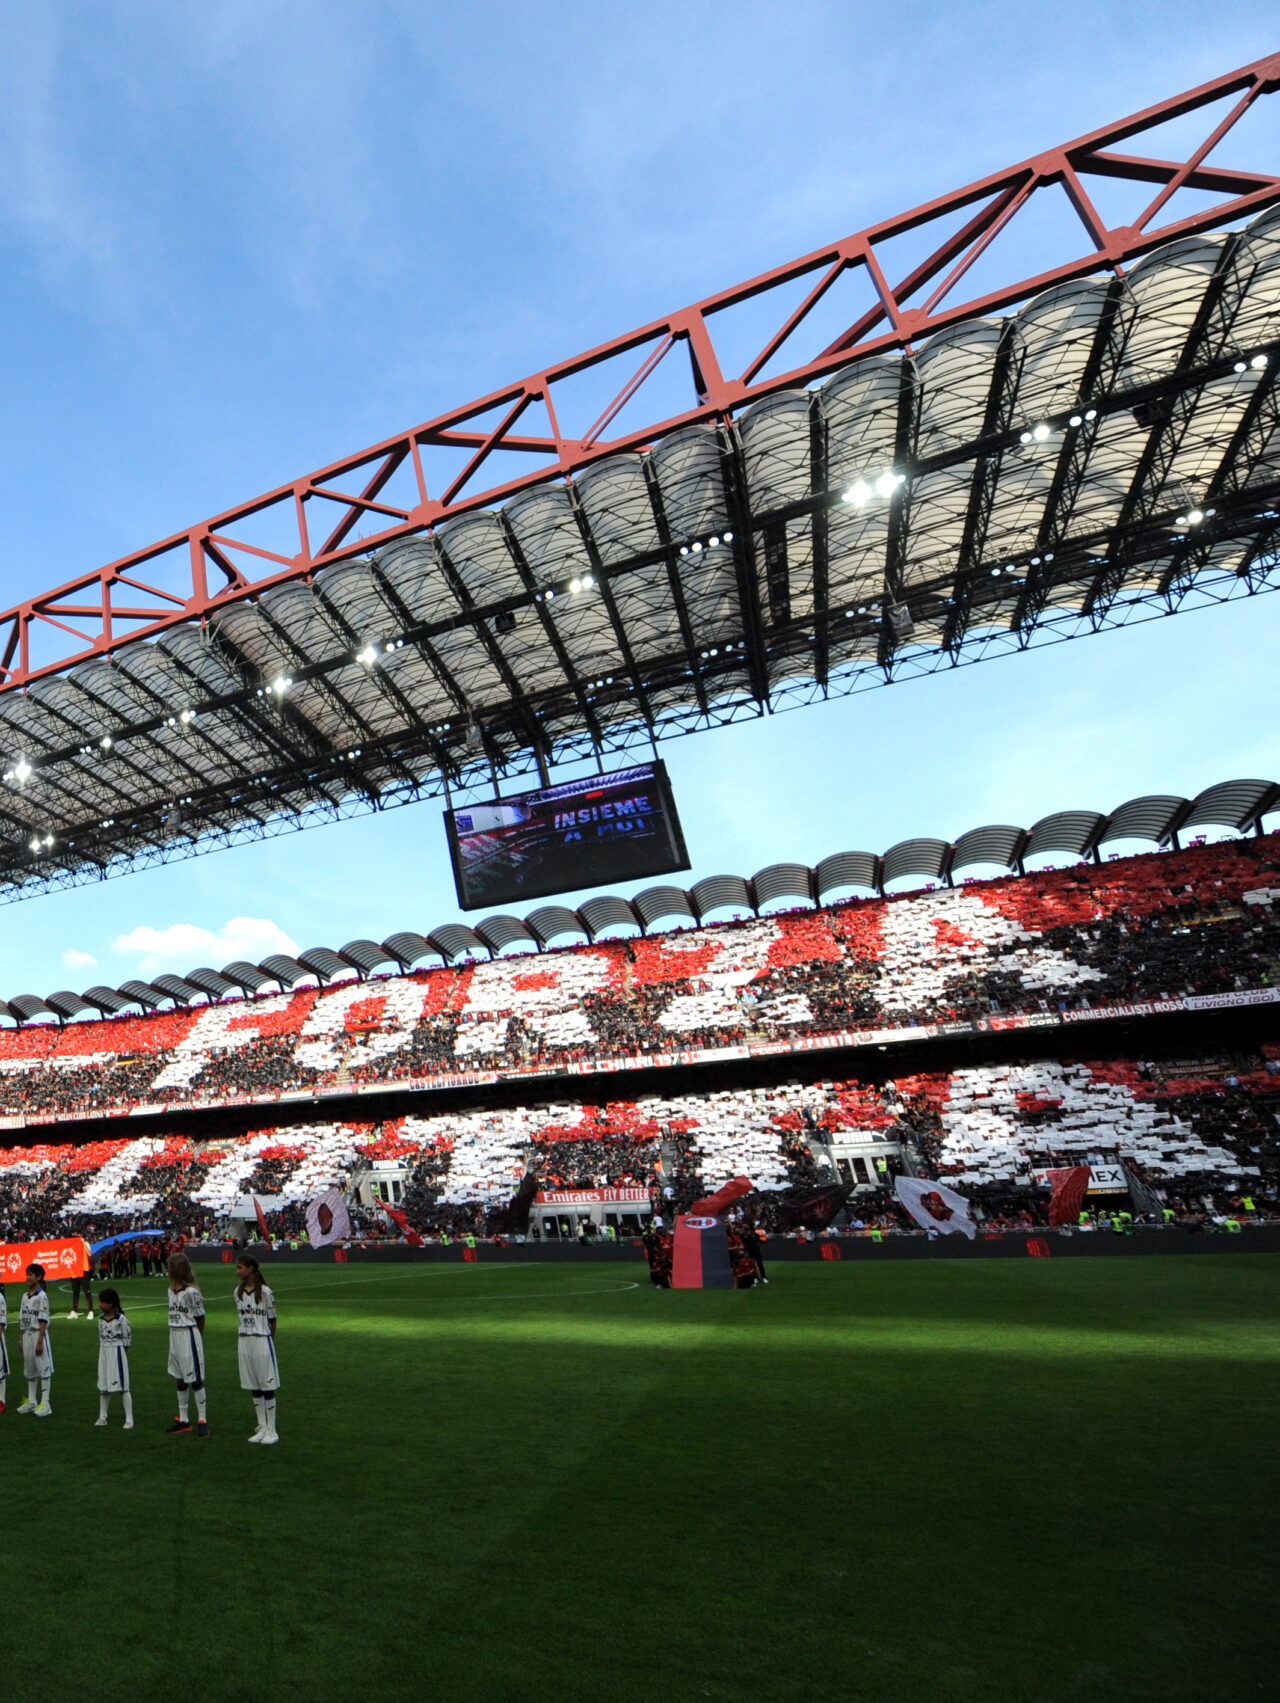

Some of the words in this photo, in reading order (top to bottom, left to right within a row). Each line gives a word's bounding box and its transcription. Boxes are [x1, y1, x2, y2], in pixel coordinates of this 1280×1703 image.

[554, 796, 652, 829] INSIEME
[1194, 998, 1245, 1009] LIVIGNO
[1248, 994, 1275, 1004] (SO)
[1062, 1003, 1153, 1022] COMMERCIALISTI
[1014, 1017, 1061, 1029] ARCORE
[657, 1052, 690, 1066] 1973
[832, 1131, 873, 1144] PUMA
[543, 1190, 600, 1203] Emirates
[603, 1189, 618, 1201] FLY
[620, 1187, 650, 1200] BETTER
